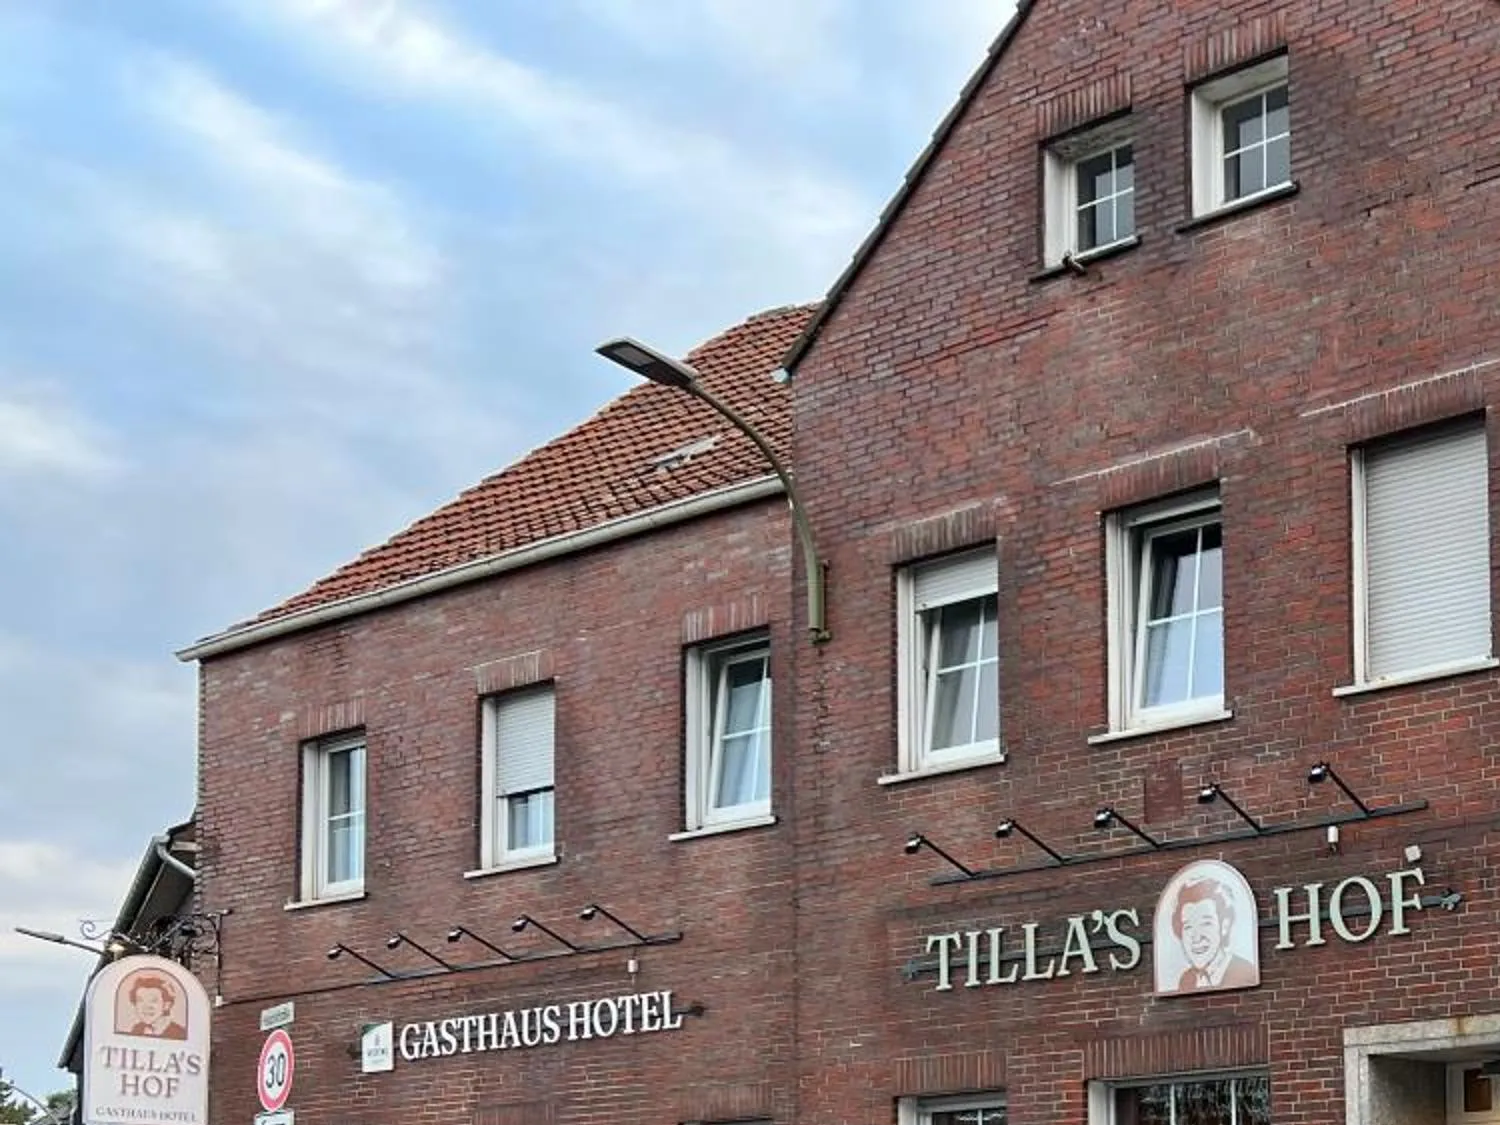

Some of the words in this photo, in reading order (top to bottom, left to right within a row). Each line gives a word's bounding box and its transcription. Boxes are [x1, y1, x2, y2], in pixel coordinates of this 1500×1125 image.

[926, 908, 1142, 992] TILLA'S
[1273, 867, 1426, 950] HOF
[399, 1004, 561, 1061] GASTHAUS
[567, 990, 683, 1041] HOTEL
[99, 1045, 202, 1075] TILLA'S
[265, 1053, 286, 1089] 30
[120, 1073, 180, 1099] HOF
